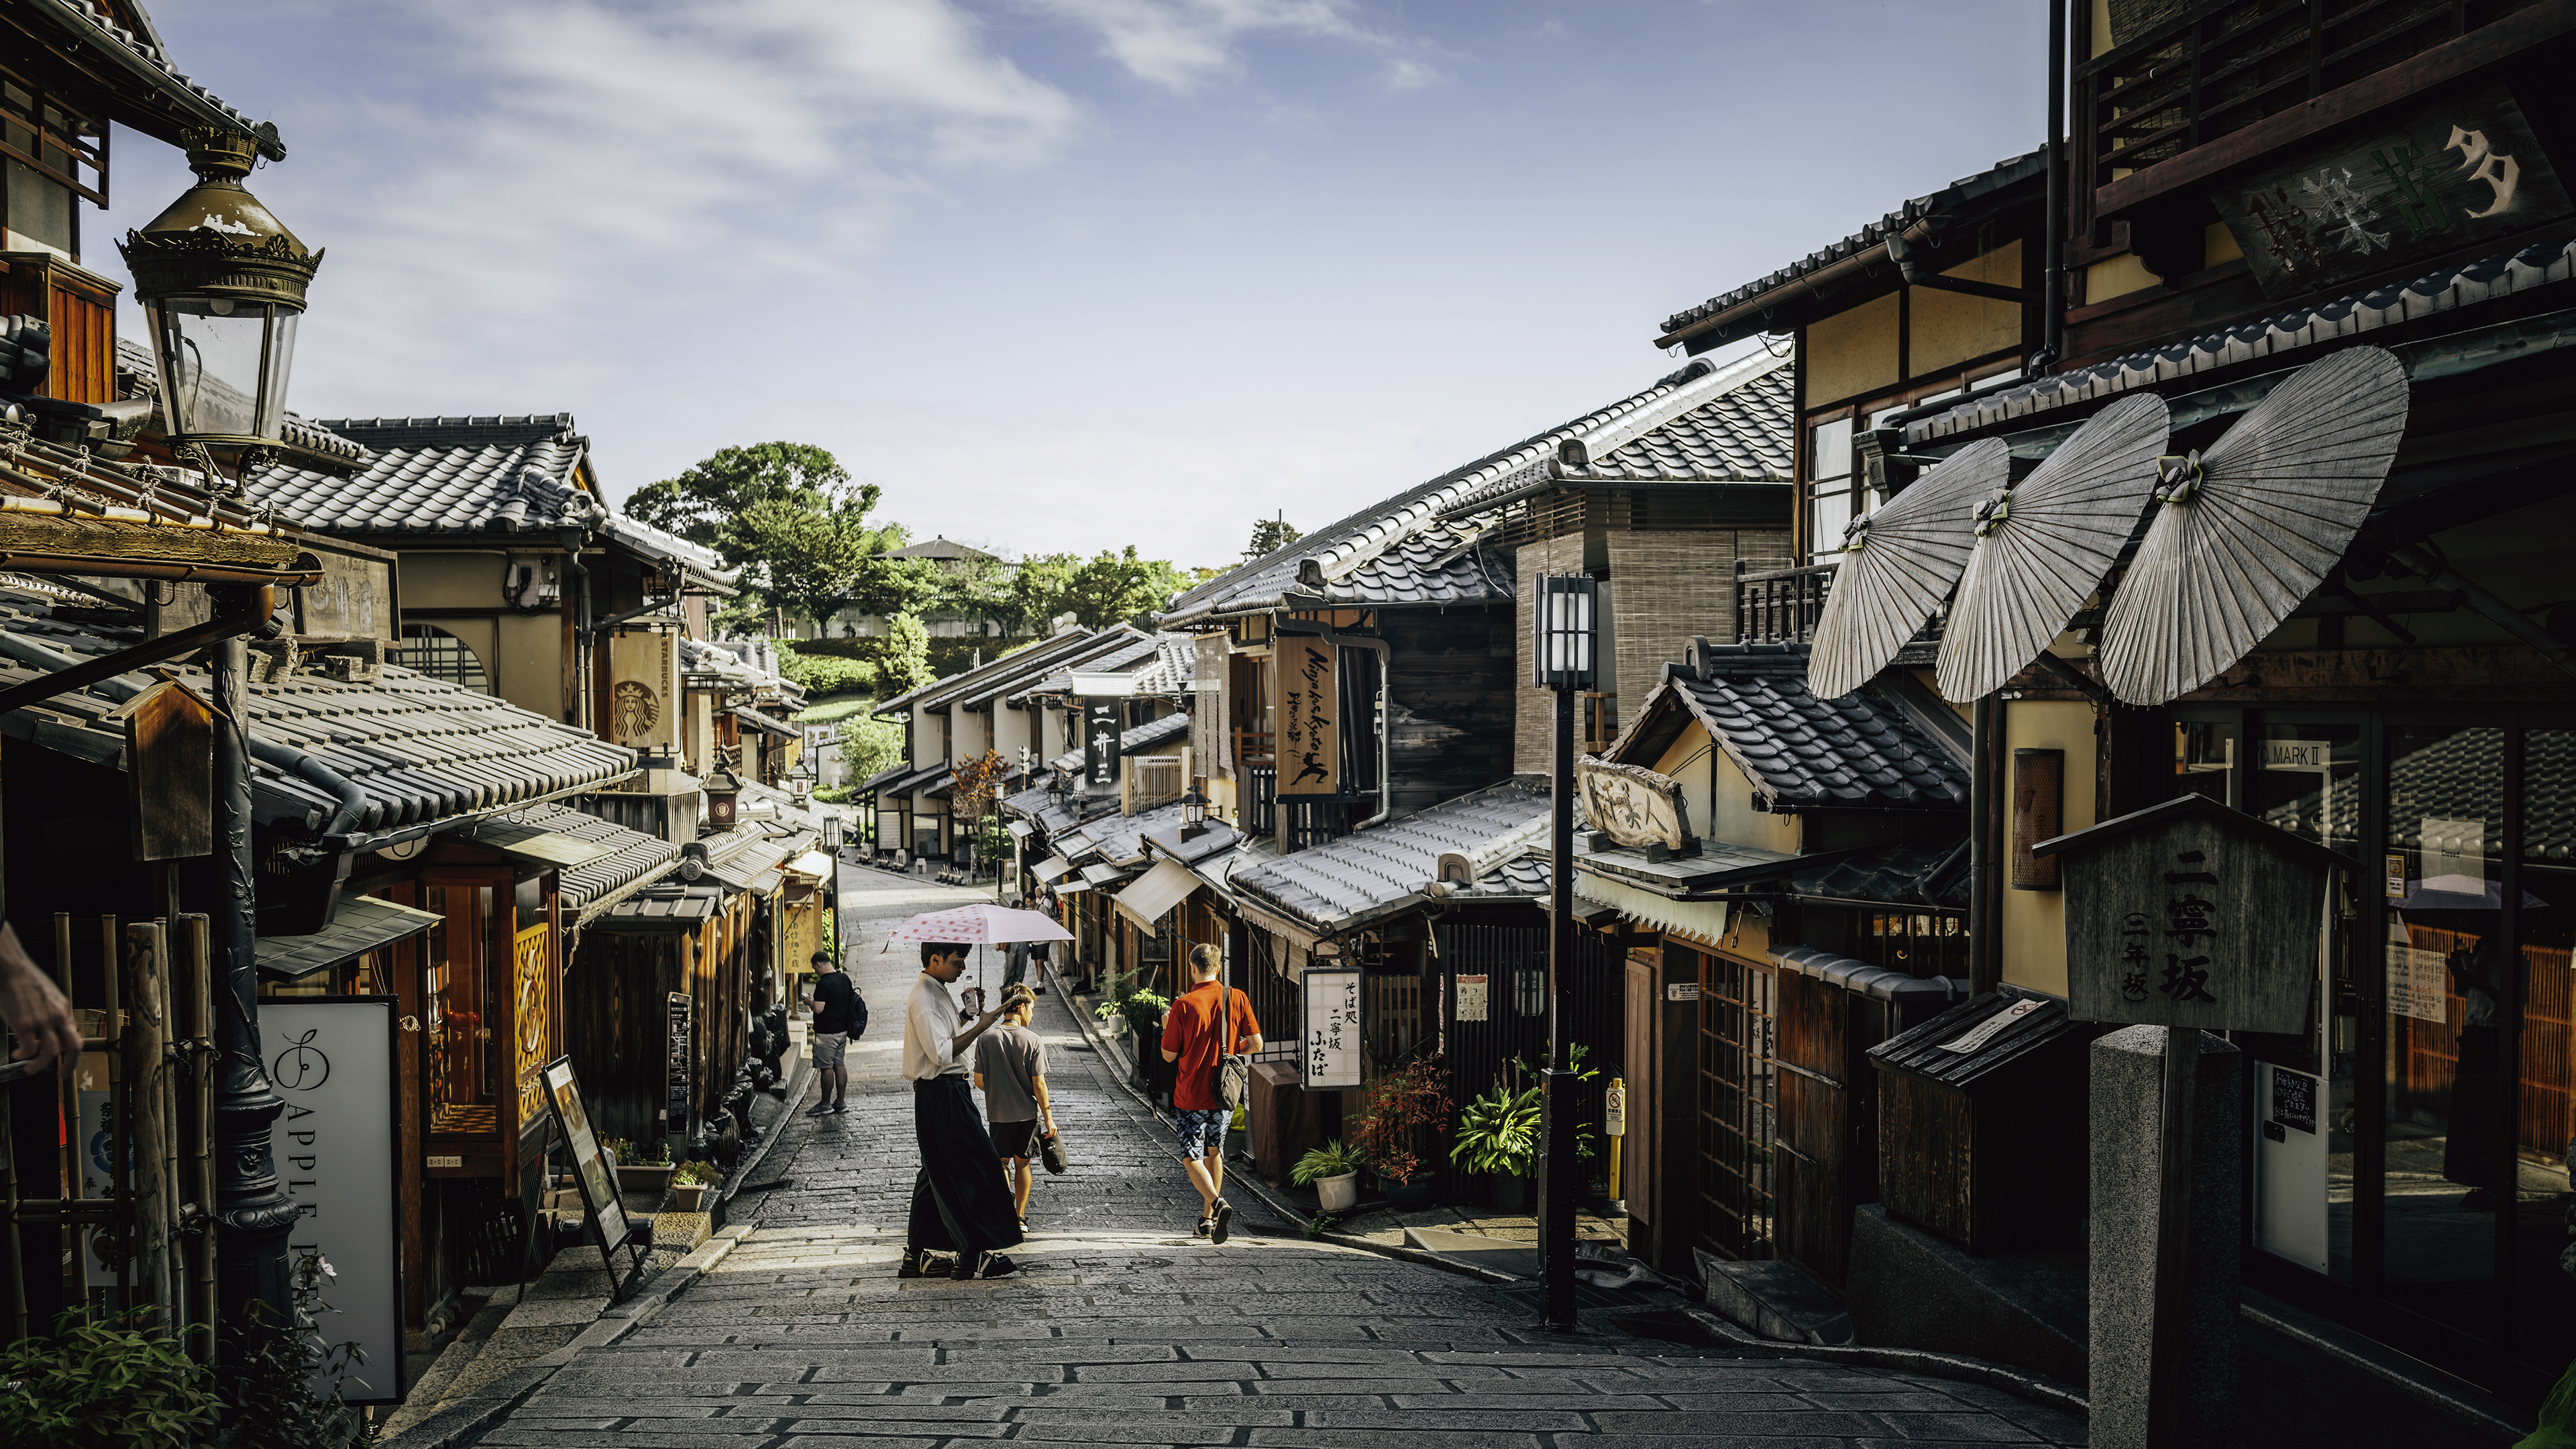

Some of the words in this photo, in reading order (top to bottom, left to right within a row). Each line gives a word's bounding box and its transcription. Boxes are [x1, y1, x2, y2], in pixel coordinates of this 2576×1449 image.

[1301, 646, 1329, 690] Ninja
[1091, 705, 1117, 784] 二井三
[1303, 715, 1330, 751] Kyoto
[2273, 746, 2308, 765] MARK
[2441, 849, 2460, 858] Closed
[2159, 850, 2218, 1003] 二寧坂
[1344, 981, 1358, 1024] そば処
[1328, 1009, 1342, 1051] 二寧坂
[1310, 1030, 1328, 1077] ふたば
